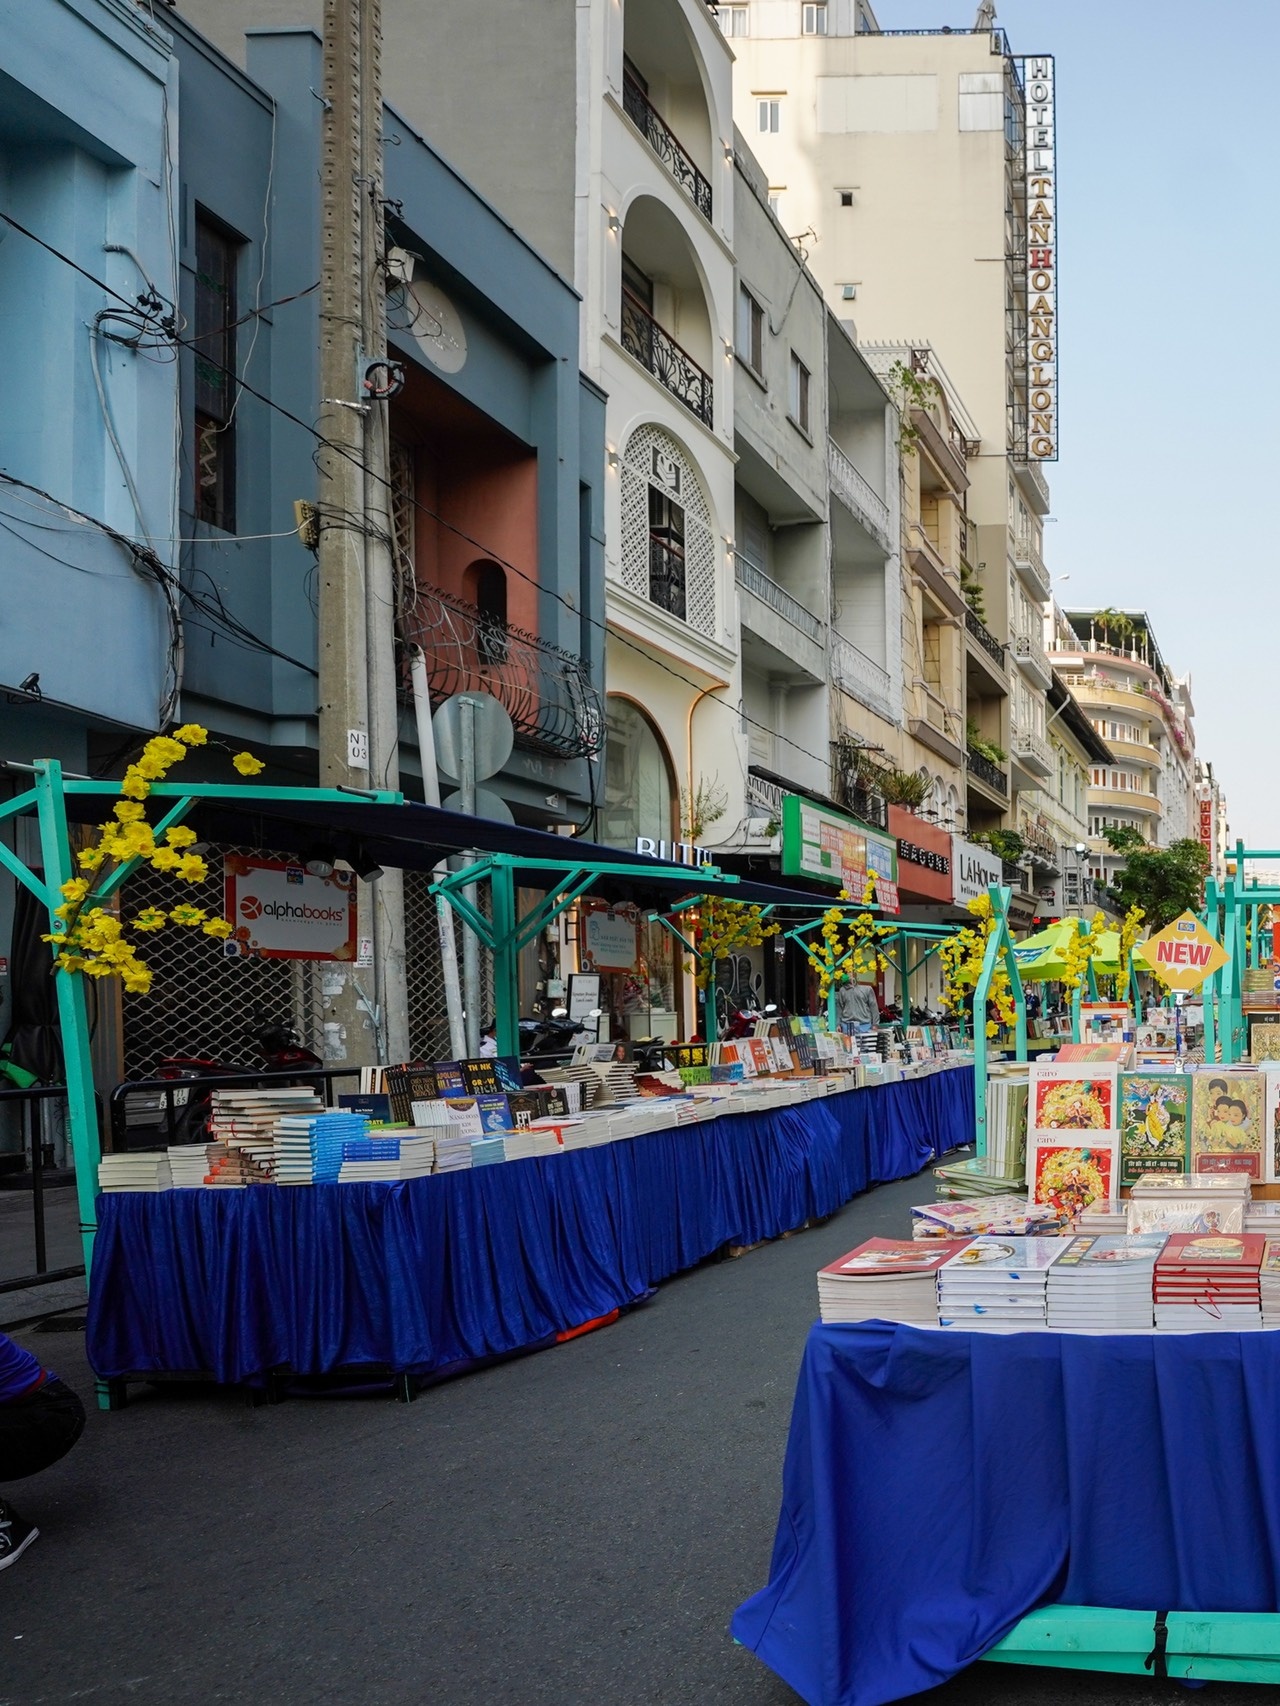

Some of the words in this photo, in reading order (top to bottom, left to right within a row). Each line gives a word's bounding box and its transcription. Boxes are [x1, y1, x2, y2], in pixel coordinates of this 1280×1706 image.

[1031, 58, 1049, 171] HOTEL
[1029, 177, 1052, 244] TAN
[1029, 248, 1054, 362] HOANG
[1031, 365, 1055, 457] LONG
[352, 747, 367, 759] 03
[263, 900, 343, 921] alphabooks
[1157, 941, 1212, 965] NEW
[473, 1084, 498, 1095] RICH
